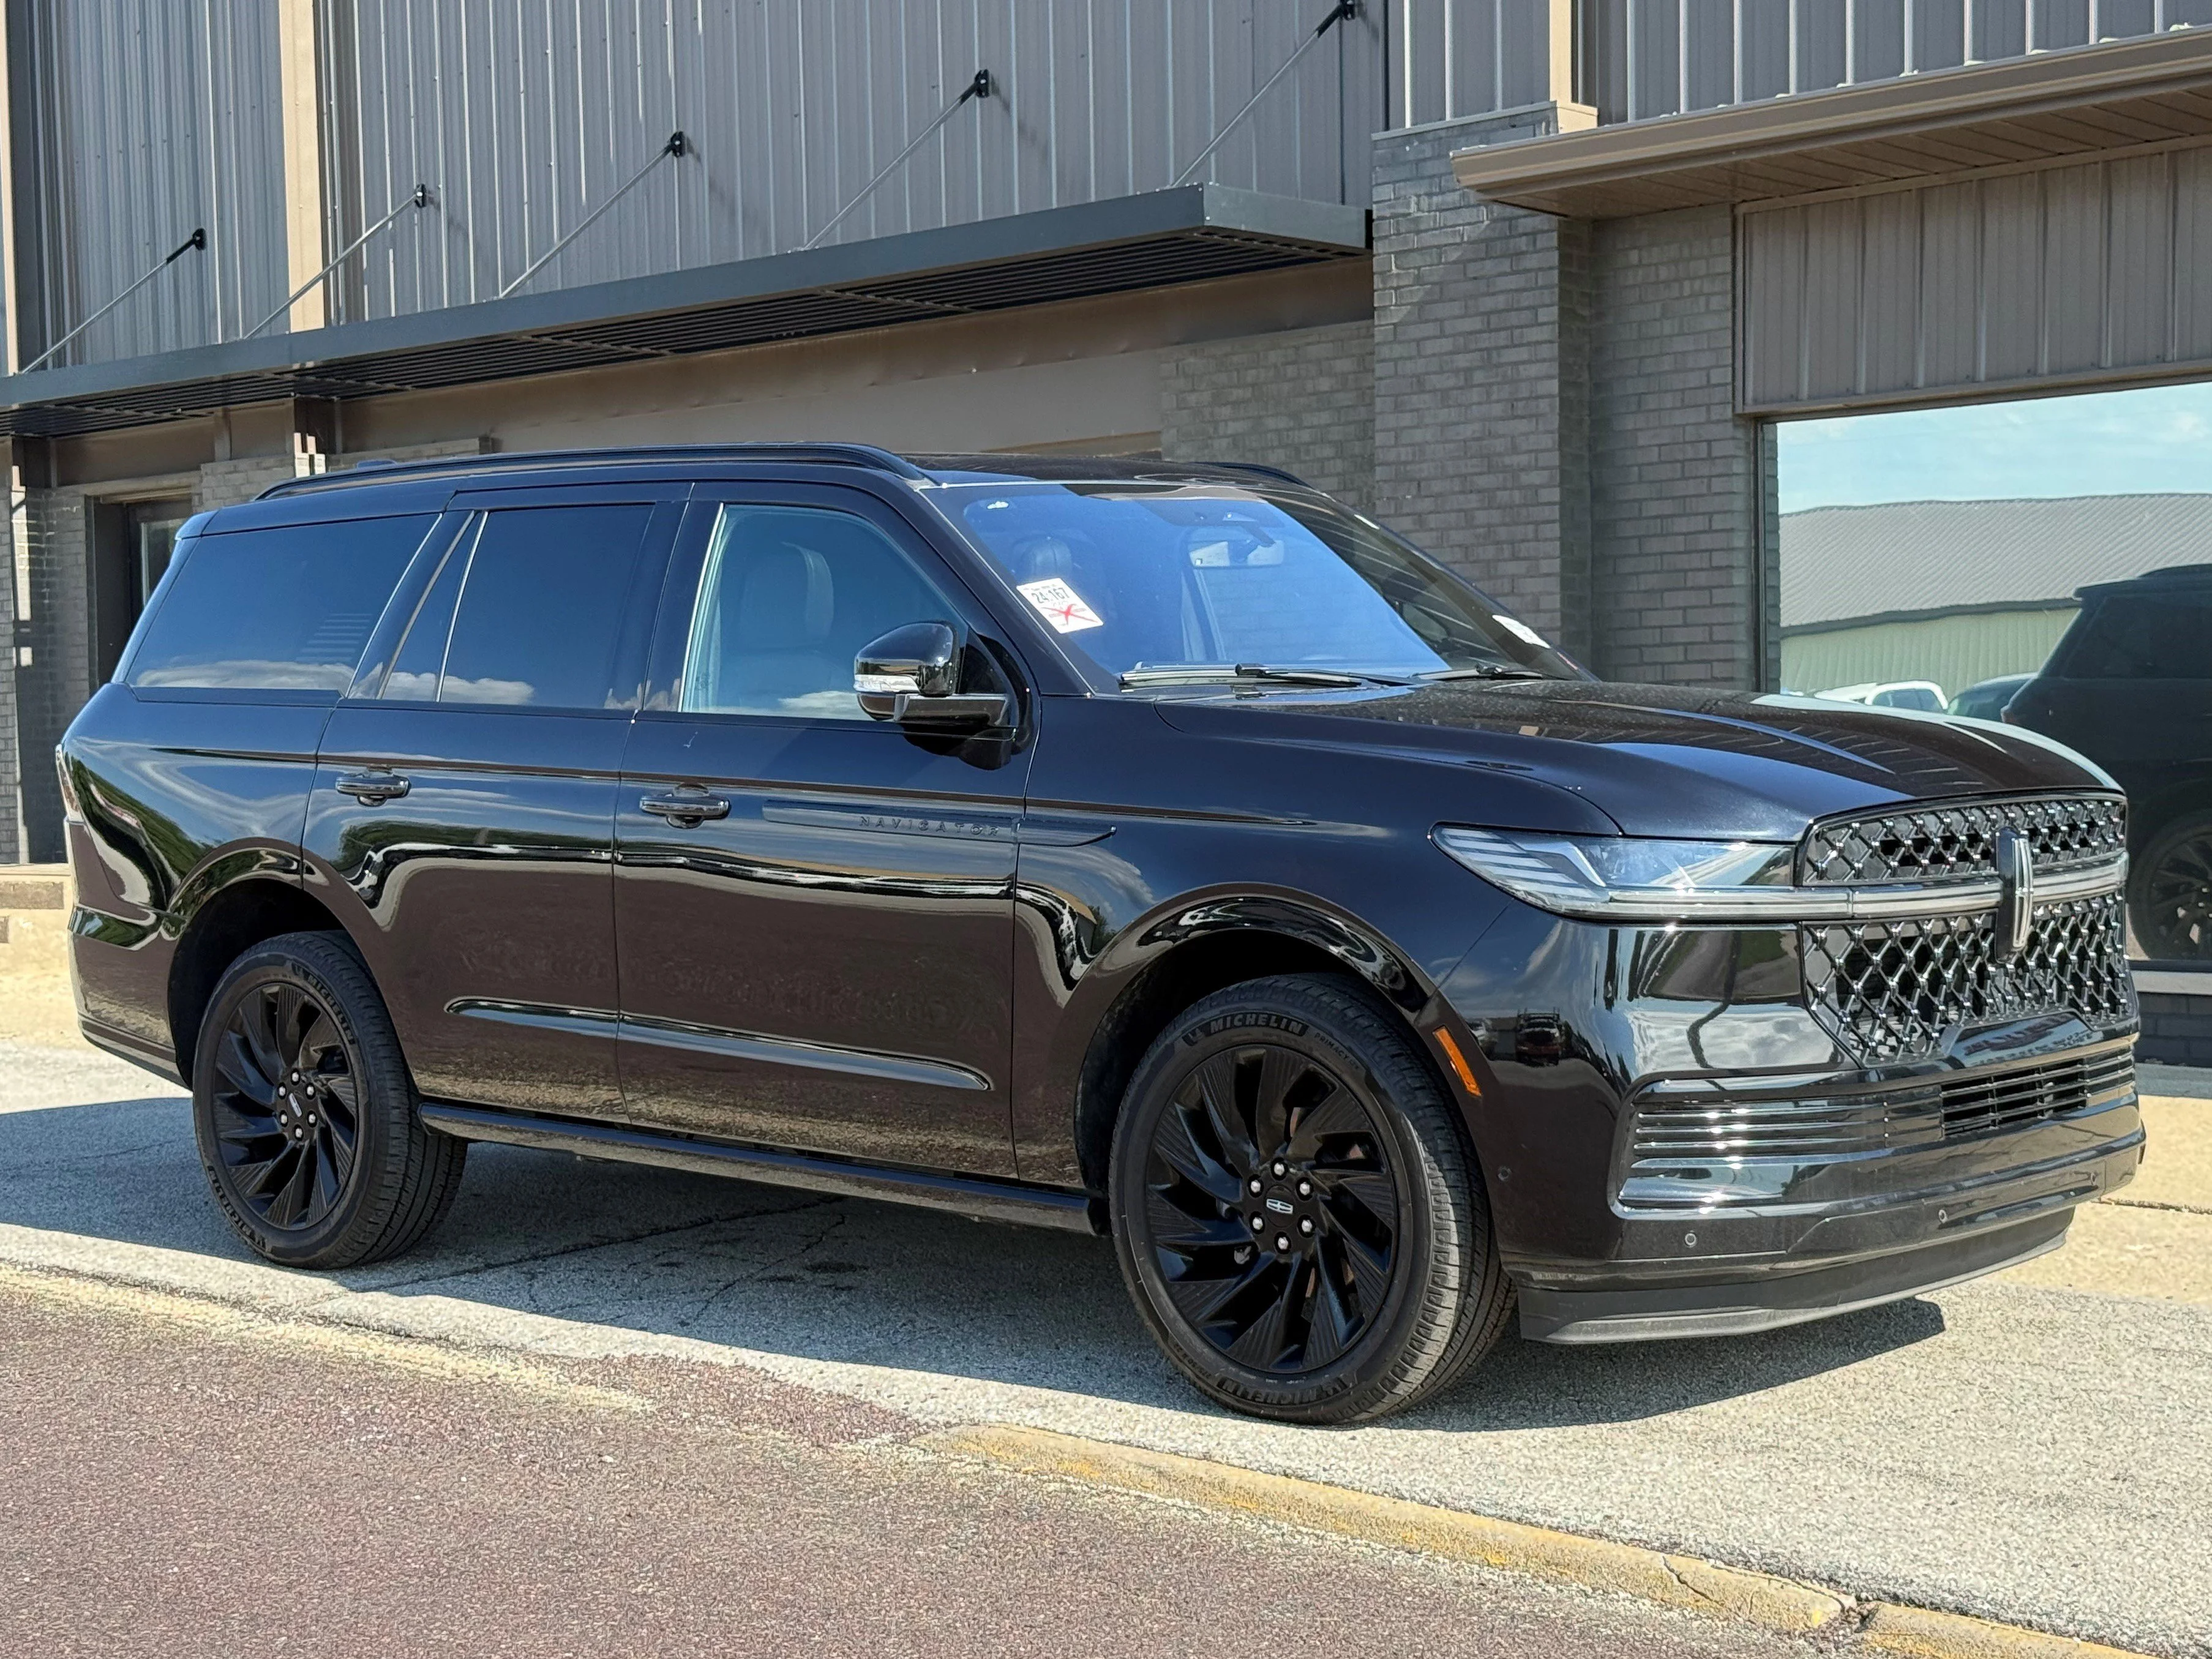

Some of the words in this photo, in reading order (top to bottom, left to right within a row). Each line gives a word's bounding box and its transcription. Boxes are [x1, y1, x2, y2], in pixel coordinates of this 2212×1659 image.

[860, 815, 999, 836] NAVIGATOR
[307, 975, 354, 1041] MICHELIN
[1210, 1014, 1302, 1035] MICHELIN
[1314, 1032, 1349, 1061] PRIMACY
[209, 1169, 252, 1236] MICHELIN
[1223, 1379, 1317, 1404] MICHELIN
